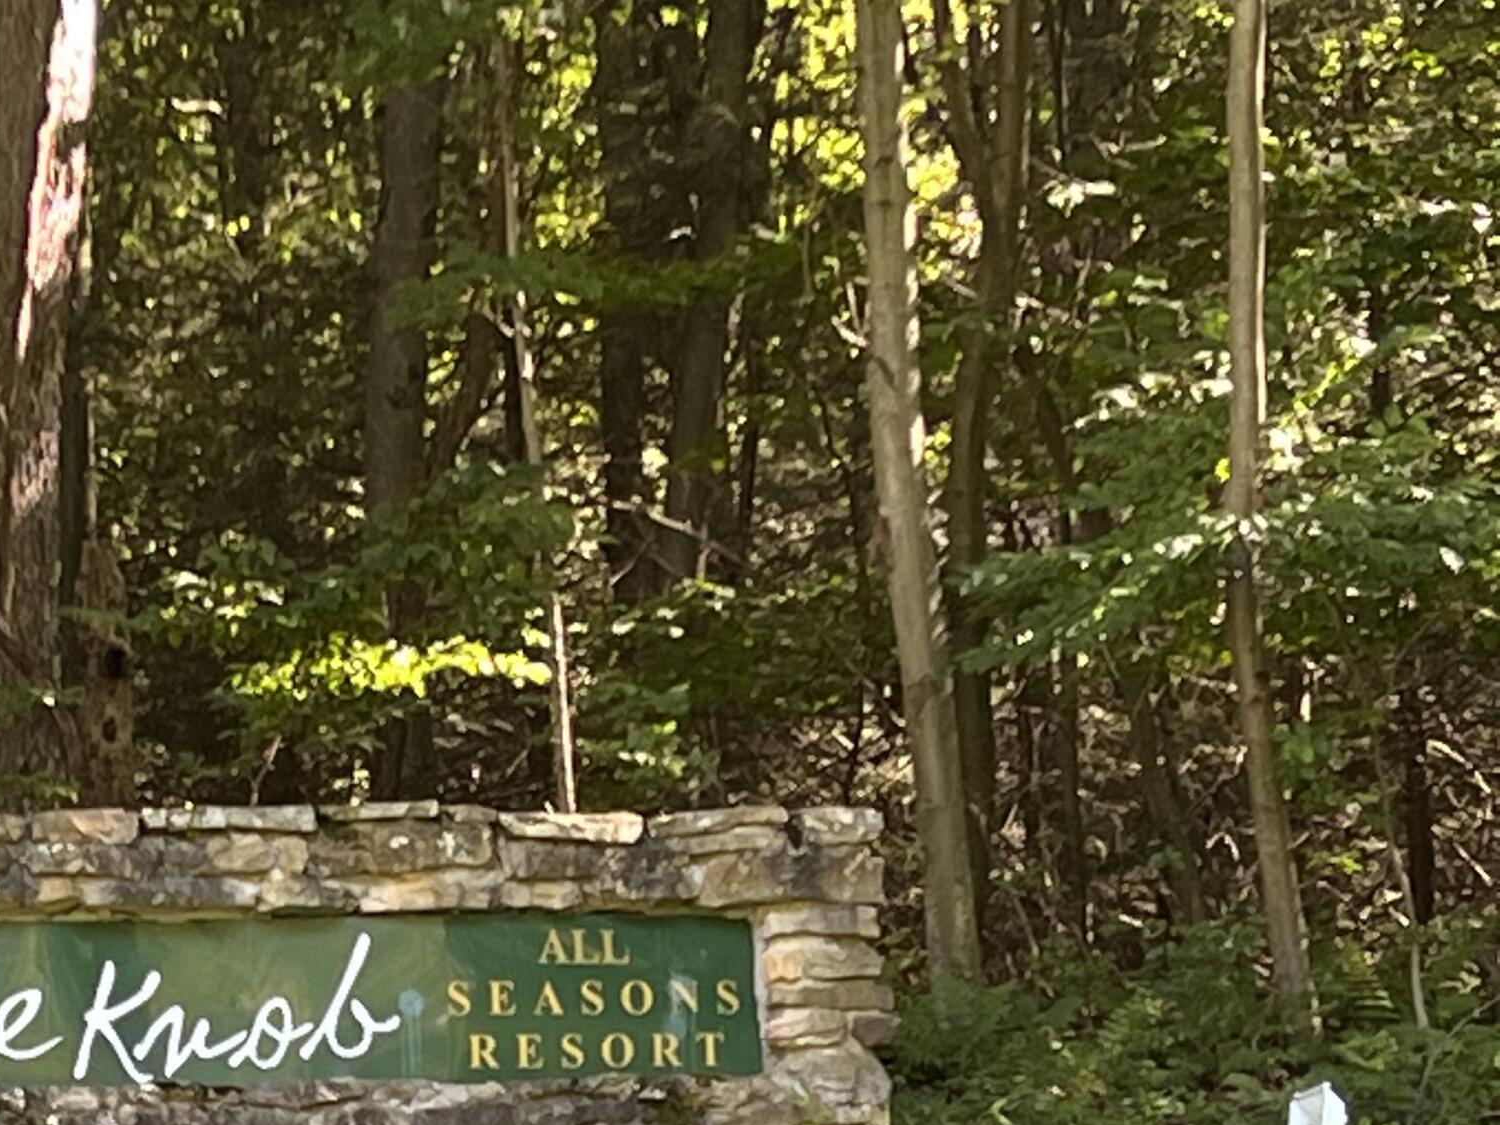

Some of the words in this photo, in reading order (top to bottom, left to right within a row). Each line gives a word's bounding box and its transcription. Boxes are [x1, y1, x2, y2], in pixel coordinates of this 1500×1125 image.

[537, 929, 631, 966] ALL
[71, 932, 400, 1085] Knob
[445, 980, 742, 1016] SEASONS
[469, 1033, 725, 1071] RESORT
